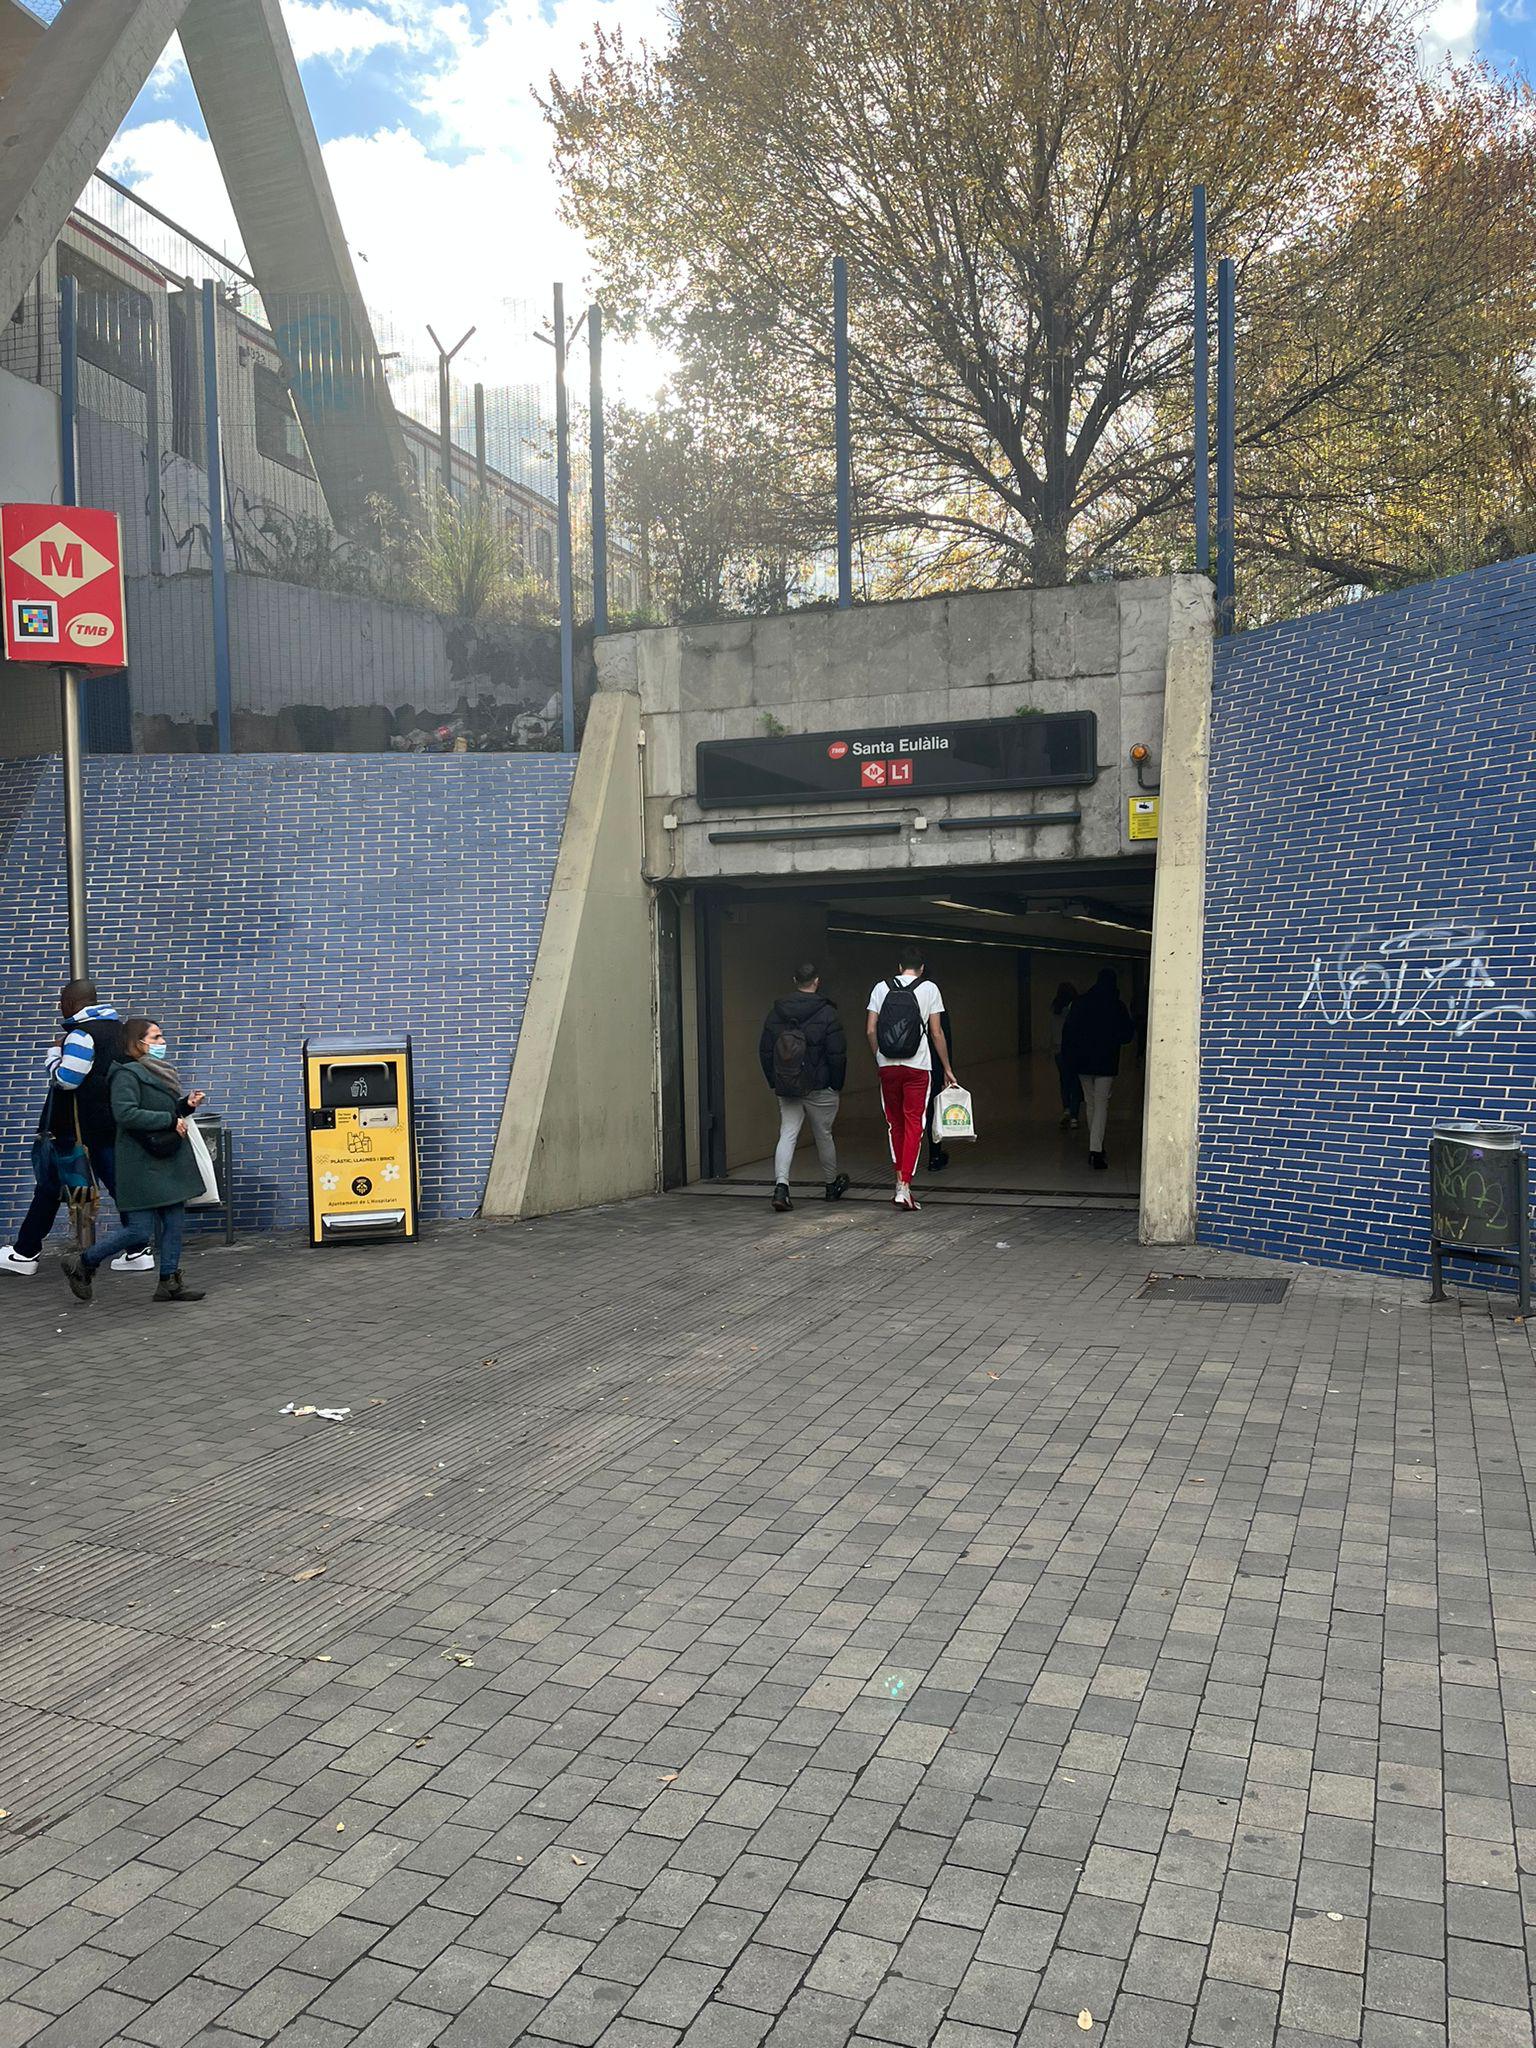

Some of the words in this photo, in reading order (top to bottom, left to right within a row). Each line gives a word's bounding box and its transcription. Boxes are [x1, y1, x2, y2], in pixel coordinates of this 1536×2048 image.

[40, 541, 84, 579] M
[75, 624, 108, 637] TMB
[831, 746, 846, 755] TMB
[852, 741, 895, 756] Santa
[899, 736, 949, 752] Eulàlia
[869, 767, 878, 775] M
[891, 764, 909, 780] L1
[328, 1200, 359, 1208] Ajuntament
